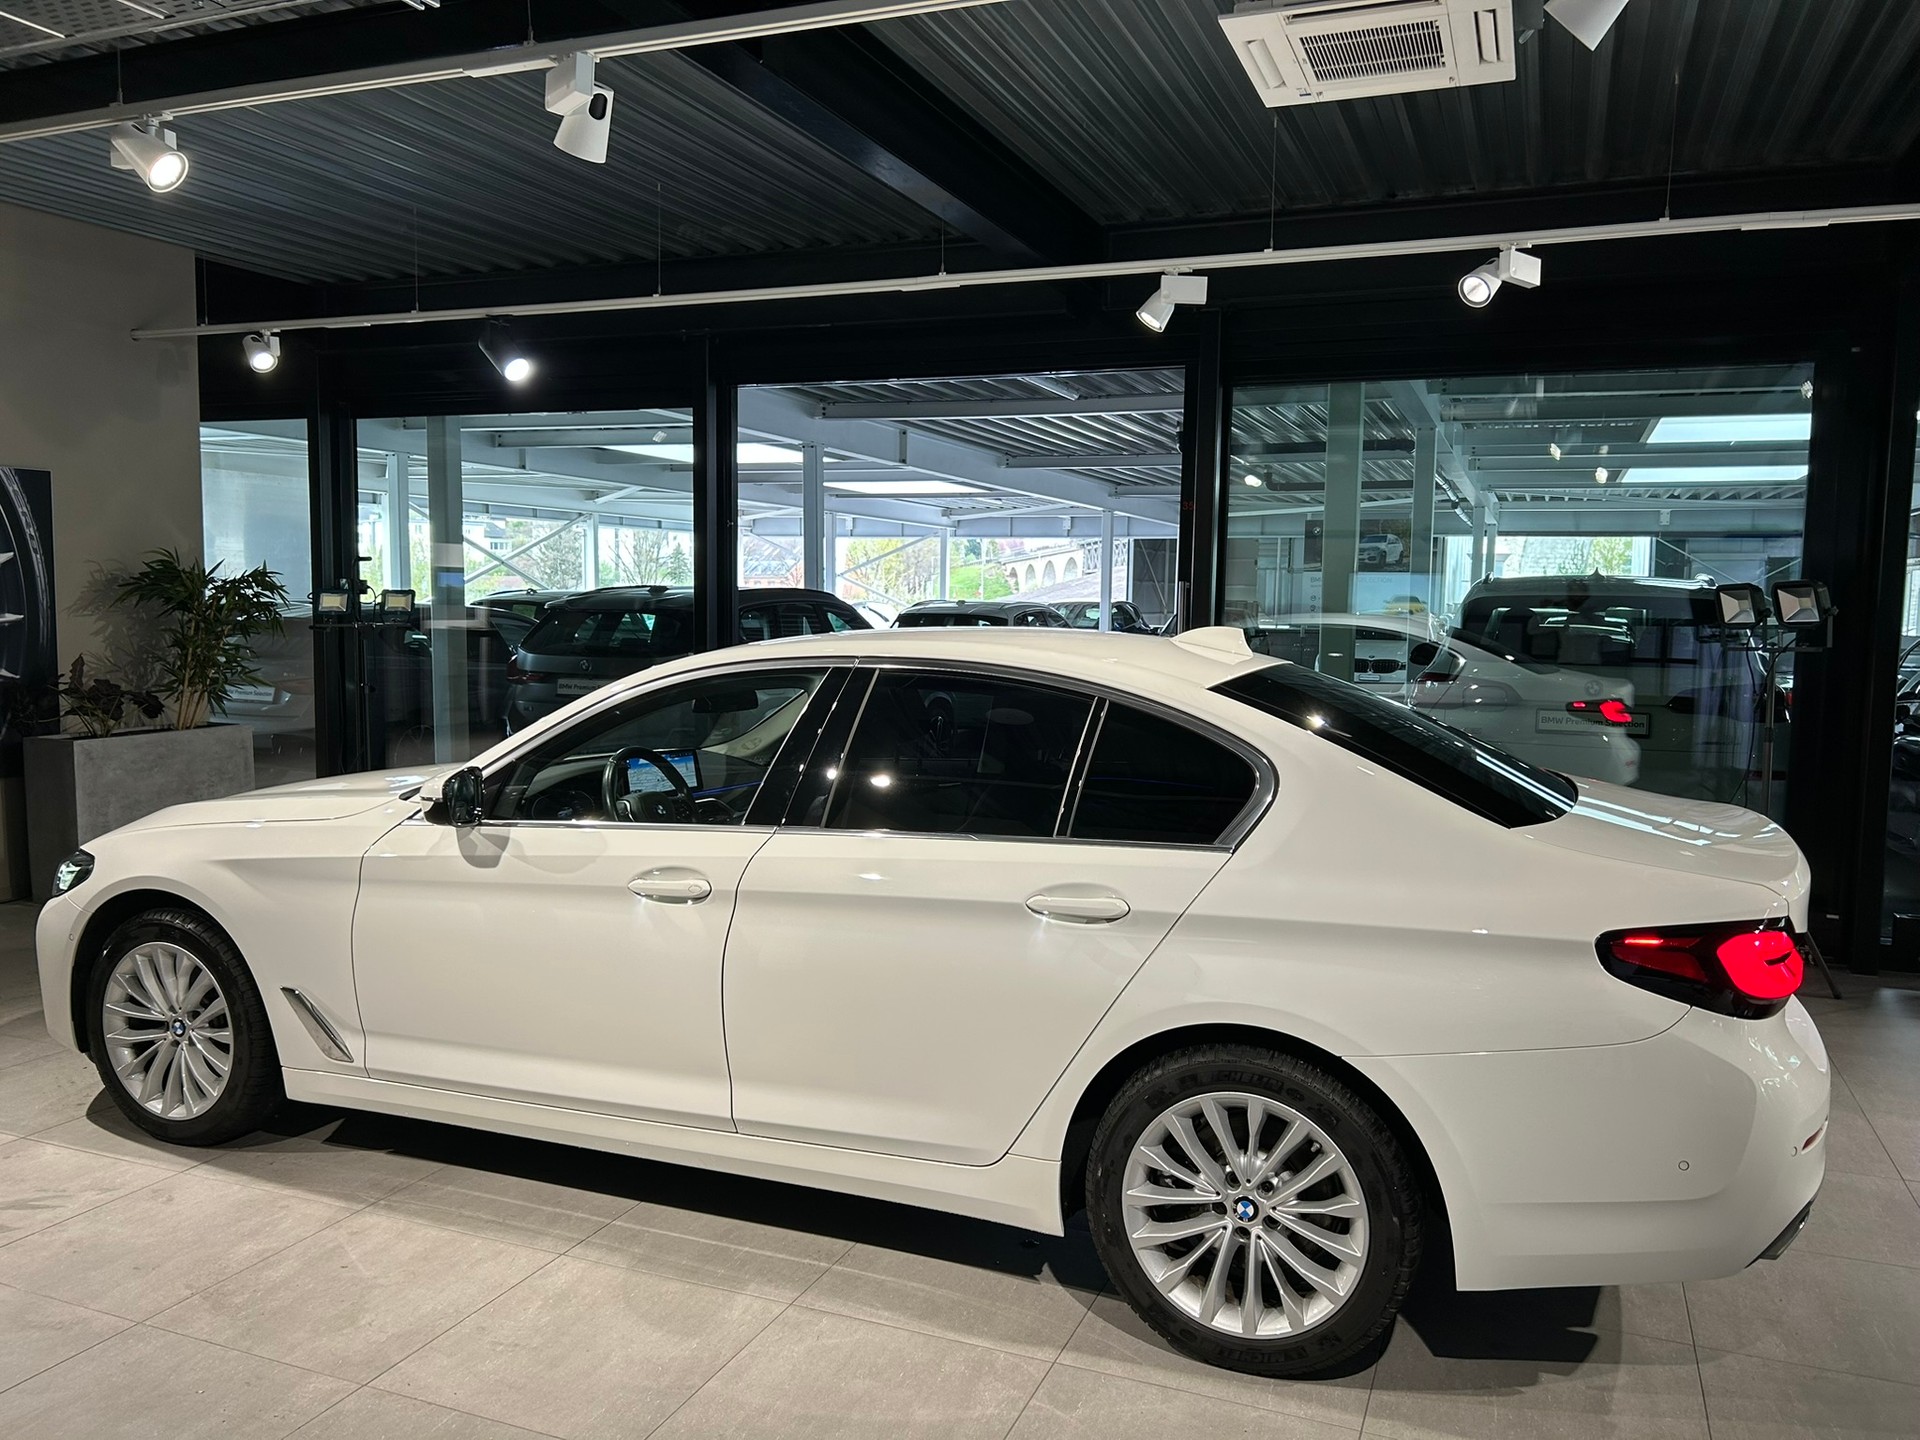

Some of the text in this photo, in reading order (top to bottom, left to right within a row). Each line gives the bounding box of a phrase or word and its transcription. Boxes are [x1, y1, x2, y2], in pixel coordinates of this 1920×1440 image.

[1540, 716, 1645, 728] BMW Premium Selection
